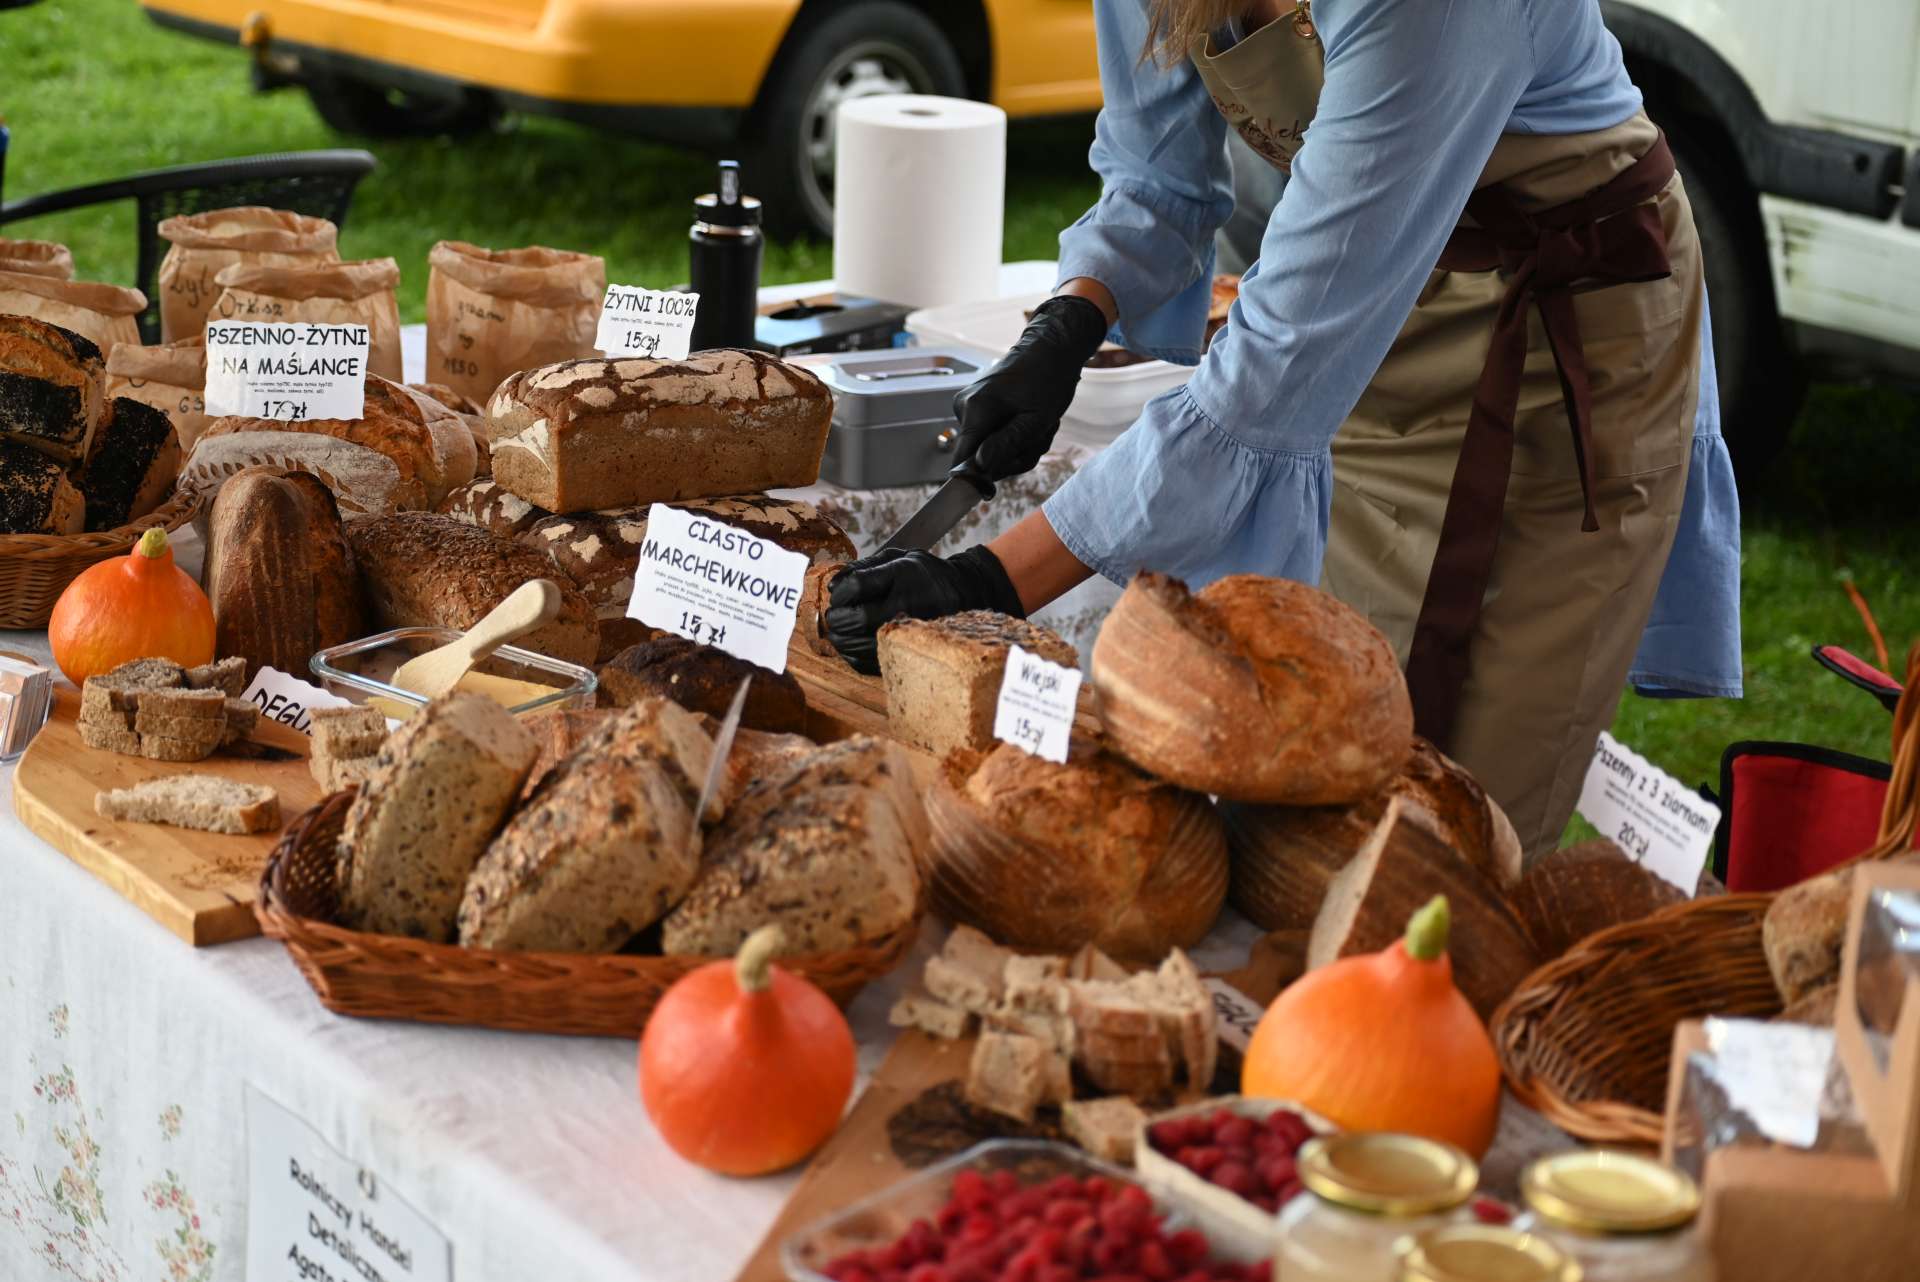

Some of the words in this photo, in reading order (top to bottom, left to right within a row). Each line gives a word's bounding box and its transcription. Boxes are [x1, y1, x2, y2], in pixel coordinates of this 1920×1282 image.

[604, 288, 653, 312] ŻYTNI
[657, 296, 695, 317] 100%
[208, 324, 367, 346] PSZENNO-ŻYTNI
[222, 356, 249, 375] NA
[257, 351, 360, 376] MAŚLANCE
[262, 400, 282, 418] 17
[293, 401, 308, 419] zł
[688, 520, 764, 560] CIASTO
[642, 539, 799, 610] MARCHEWKOWE
[679, 611, 702, 635] 15
[708, 625, 727, 644] zł
[252, 688, 313, 736] DEGU
[1638, 776, 1649, 791] z
[1650, 778, 1660, 798] 3
[289, 1156, 352, 1229] Rolniczy
[359, 1210, 412, 1273] Handel
